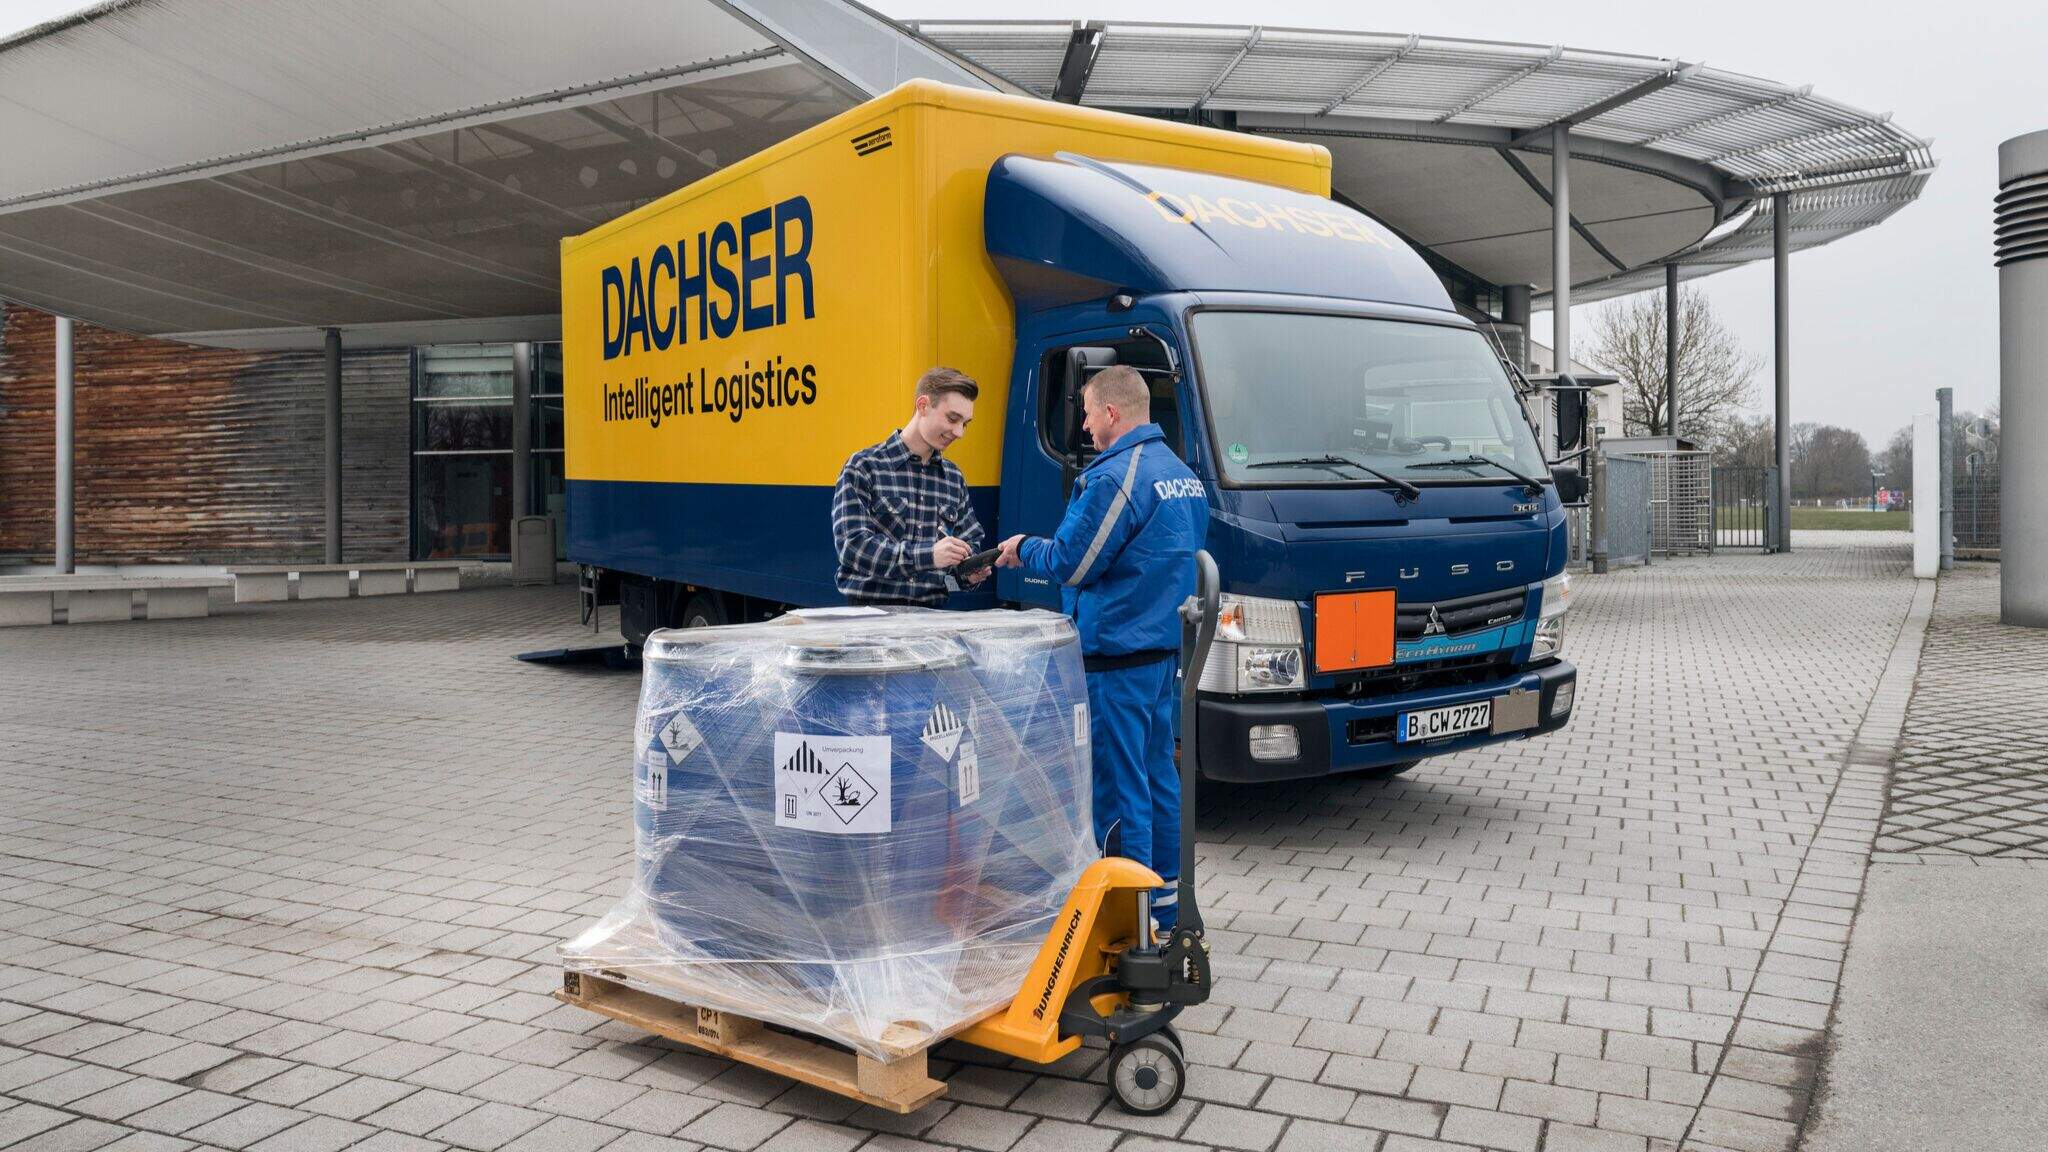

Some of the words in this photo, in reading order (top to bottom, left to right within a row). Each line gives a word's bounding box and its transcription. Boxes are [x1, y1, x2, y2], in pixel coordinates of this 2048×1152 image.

[1148, 190, 1393, 250] DACHSER
[602, 195, 816, 361] DACHSER
[604, 372, 694, 428] Intelligent
[701, 355, 817, 423] Logistics
[1154, 479, 1207, 500] DACHSER
[1024, 577, 1049, 585] DUONIC
[1345, 560, 1515, 583] FUSO
[1409, 715, 1419, 737] B
[1429, 710, 1450, 734] CW
[1453, 704, 1489, 730] 2727
[822, 745, 864, 754] Umverpackung
[1033, 909, 1082, 1020] JUNGHEINRICH
[701, 1007, 712, 1021] CP
[713, 1011, 718, 1025] 1
